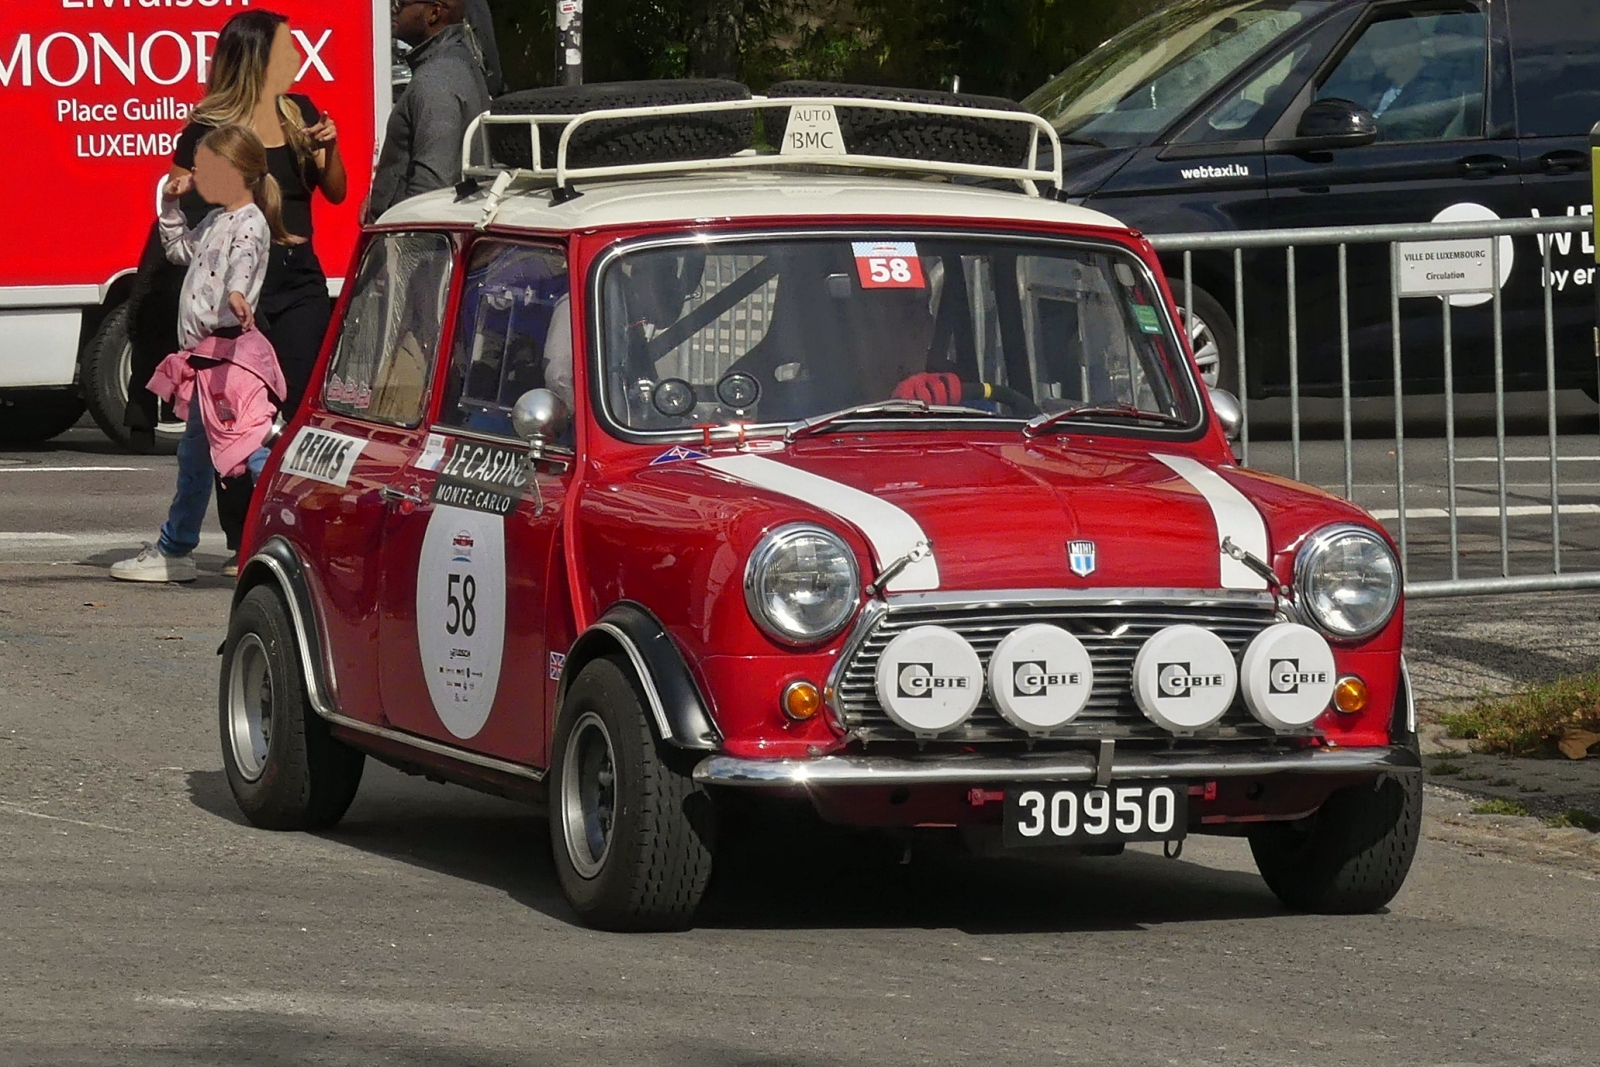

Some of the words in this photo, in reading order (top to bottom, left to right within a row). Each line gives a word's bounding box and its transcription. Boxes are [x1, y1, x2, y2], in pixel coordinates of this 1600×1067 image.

[0, 29, 334, 87] MONOPX
[57, 98, 118, 122] Place
[123, 97, 195, 121] Guilla
[794, 109, 831, 121] AUTO
[791, 131, 834, 149] BMC
[1180, 164, 1249, 179] webtaxi.lu
[1404, 252, 1423, 262] VILLE
[1425, 252, 1435, 261] DE
[1436, 249, 1486, 261] LUXEMBOURG
[868, 258, 912, 283] 58
[1425, 270, 1466, 281] Circulation
[289, 431, 355, 481] REIMS
[1070, 542, 1093, 554] MINI
[446, 573, 476, 637] 58
[1018, 786, 1175, 837] 30950
